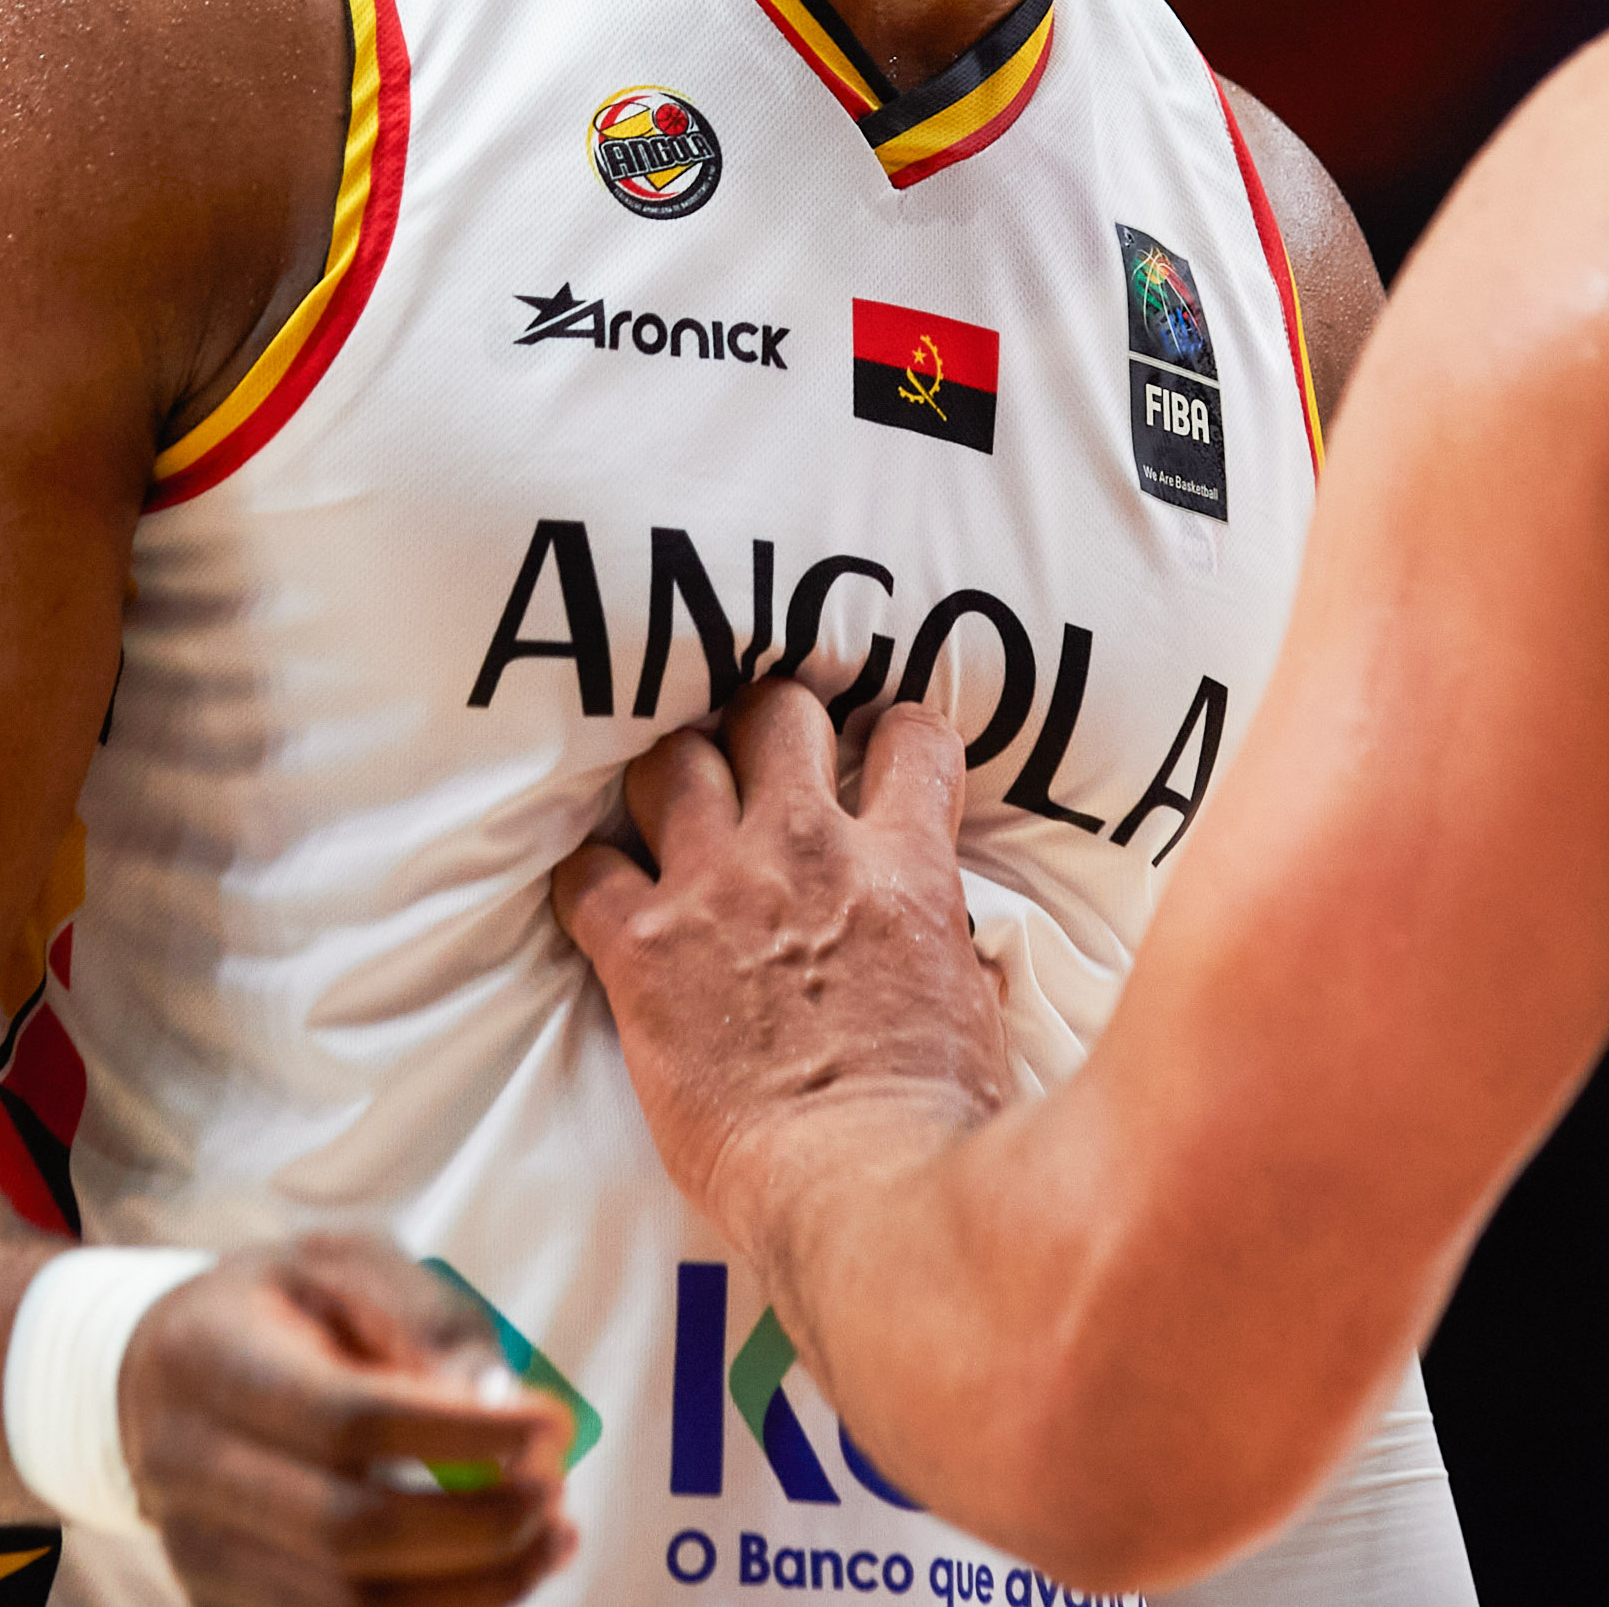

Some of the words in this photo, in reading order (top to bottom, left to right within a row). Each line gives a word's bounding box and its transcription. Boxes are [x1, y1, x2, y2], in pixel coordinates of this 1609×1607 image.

[600, 133, 715, 180] ANGOLA
[1145, 383, 1210, 444] FIBA
[1143, 464, 1158, 481] We
[1159, 470, 1174, 487] Are
[1175, 475, 1219, 500] Basketball
[466, 518, 1229, 868] ANGOLA
[666, 1529, 717, 1586] O
[739, 1531, 914, 1595] Banco
[928, 1556, 995, 1607] que
